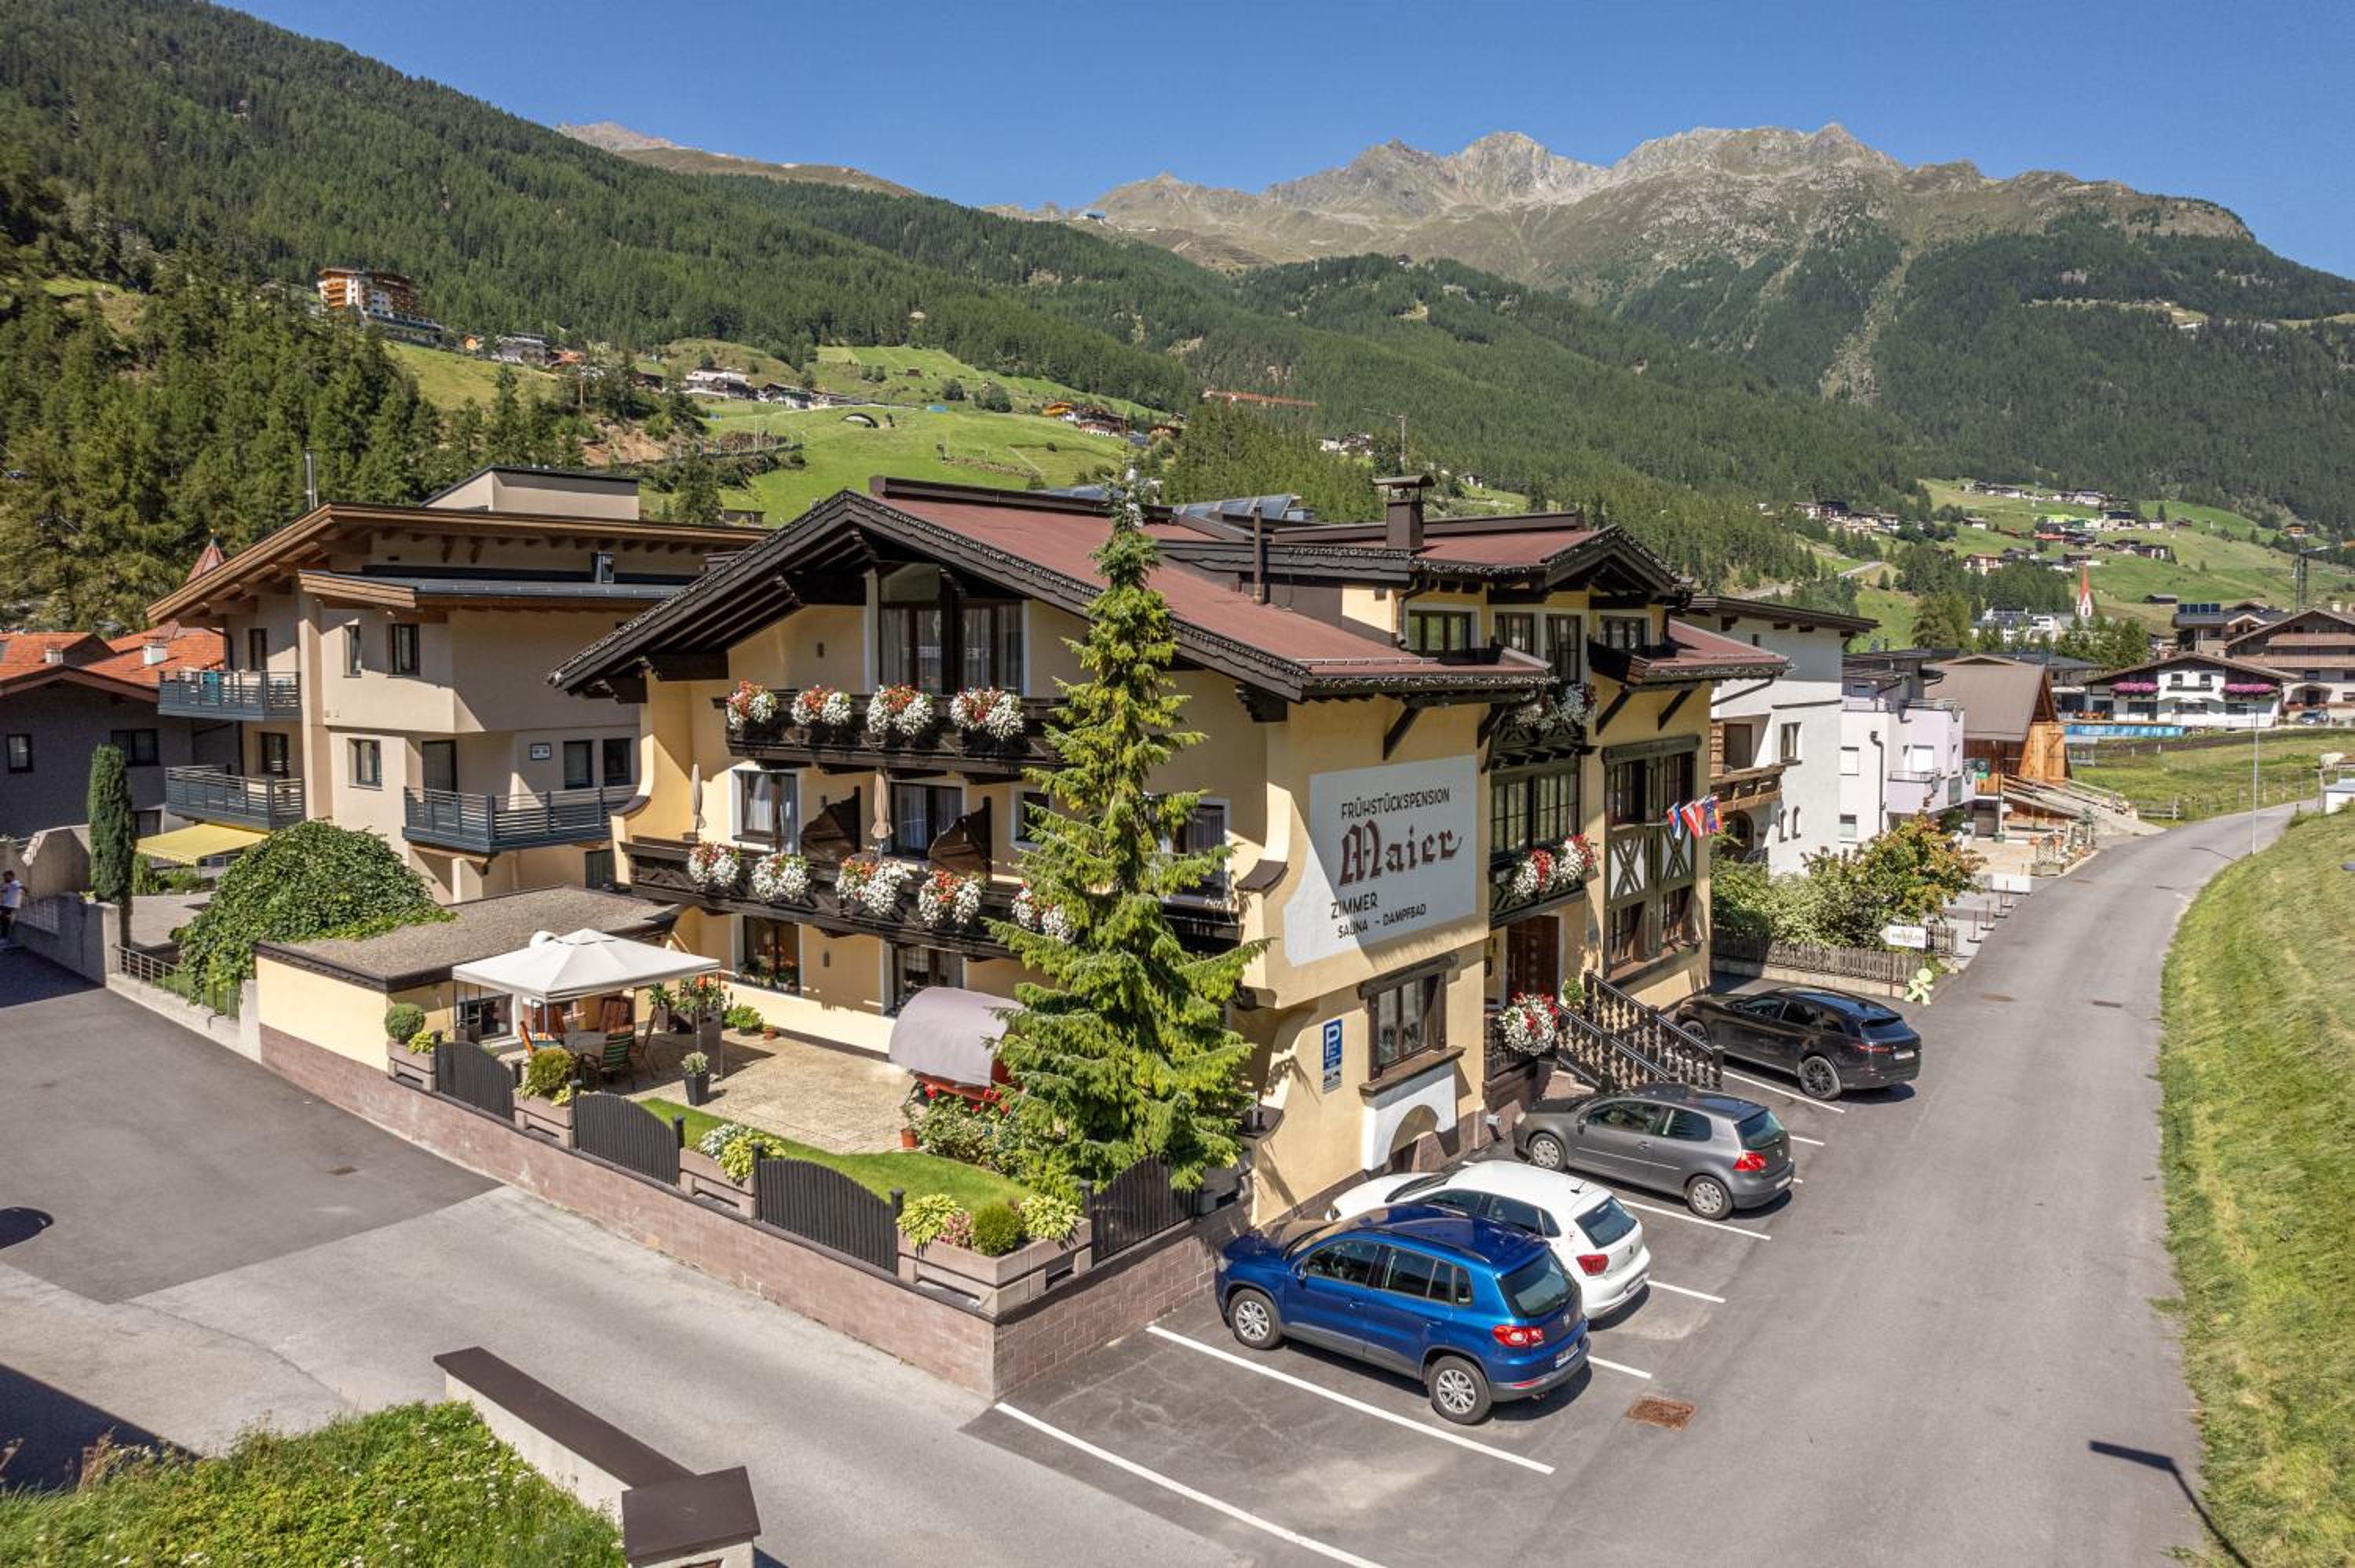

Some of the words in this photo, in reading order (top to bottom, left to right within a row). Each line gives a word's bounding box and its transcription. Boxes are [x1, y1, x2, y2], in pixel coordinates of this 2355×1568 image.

[1341, 788, 1450, 819] FRÜHSTÜCKSPENSION
[1338, 819, 1462, 886] Maier
[1331, 892, 1378, 919] ZIMMER
[1338, 920, 1368, 939] SAUNA
[1382, 903, 1426, 925] DAMPFBAD
[1326, 1024, 1340, 1057] P
